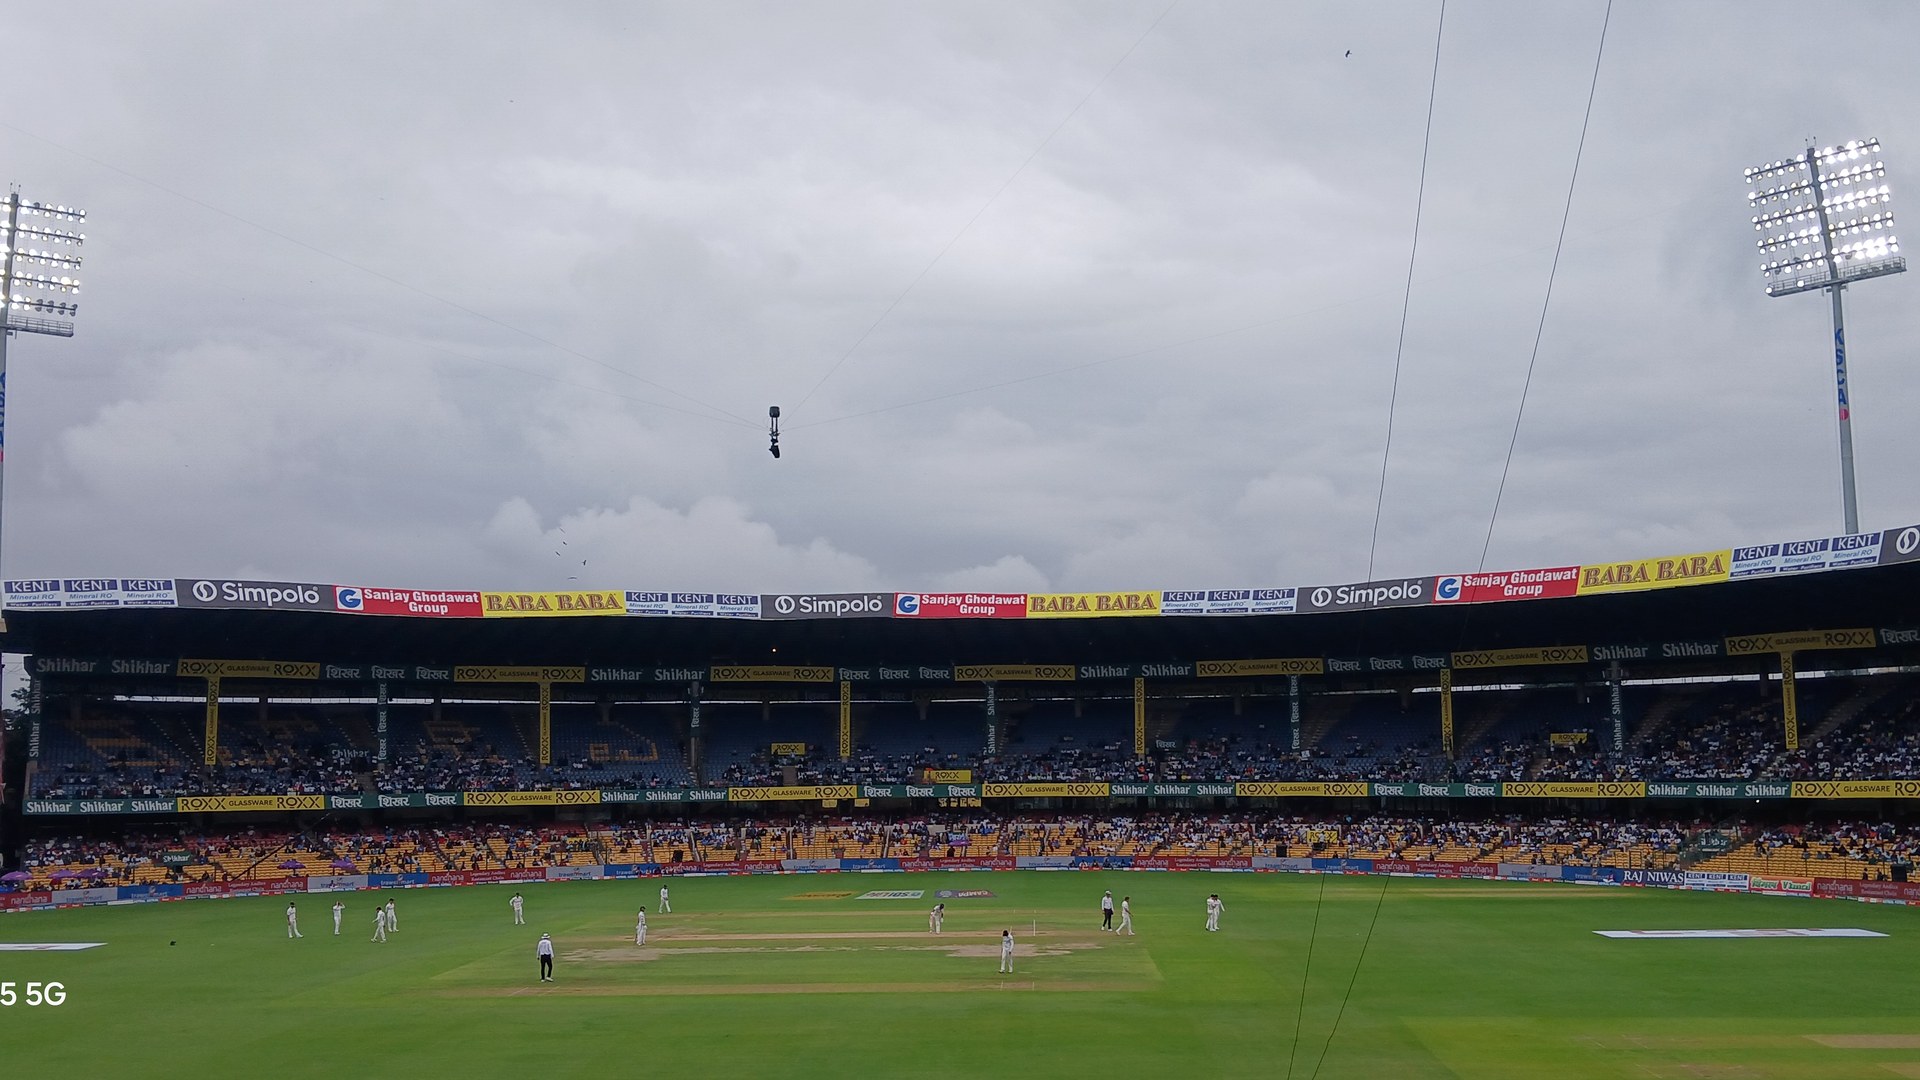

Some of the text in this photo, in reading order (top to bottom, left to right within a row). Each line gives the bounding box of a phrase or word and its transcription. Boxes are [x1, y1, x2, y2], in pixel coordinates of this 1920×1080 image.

[1788, 541, 1823, 555] KENT
[1838, 535, 1873, 549] KENT
[1738, 546, 1773, 560] KENT
[1833, 550, 1859, 559] Mineral
[1734, 561, 1760, 570] Mineral
[1784, 556, 1809, 564] Mineral
[1463, 568, 1577, 587] Sanjay Ghodawat
[1582, 555, 1725, 588] BABA BABA
[11, 581, 52, 592] KENT
[71, 580, 110, 591] KENT
[128, 580, 166, 591] KENT
[1504, 584, 1543, 597] Group
[221, 582, 320, 607] Simpolo
[364, 589, 479, 604] Sanjay Ghodawat
[631, 592, 662, 602] KENT
[675, 593, 708, 603] KENT
[720, 594, 752, 605] KENT
[921, 594, 1025, 606] Sanjay Ghodawat
[1168, 592, 1199, 601] KENT
[1213, 591, 1244, 600] KENT
[1257, 589, 1289, 600] KENT
[1335, 583, 1422, 606] Simpolo
[408, 602, 449, 615] Group
[485, 593, 623, 612] BABA BABA
[799, 595, 883, 615] Simpolo
[1030, 594, 1158, 612] BABA BABA
[960, 604, 996, 616] Group
[1728, 631, 1872, 651] ROXX ROXX
[1454, 648, 1584, 667] ROXX ROXX
[1593, 642, 1719, 660] Shikhar Shikhar
[36, 658, 170, 674] Shikhar Shikhar
[180, 662, 317, 677] ROXX ROXX
[957, 667, 993, 678] ROXX
[1035, 667, 1072, 678] ROXX
[1080, 664, 1190, 678] Shikhar Shikhar
[1200, 661, 1320, 674] ROXX ROXX
[457, 668, 498, 680] ROXX
[542, 669, 581, 680] ROXX
[591, 668, 704, 681] Shikhar Shikhar
[713, 668, 751, 679] ROXX
[793, 668, 831, 680] ROXX
[732, 788, 771, 799] ROXX
[815, 787, 854, 798] ROXX
[863, 784, 977, 797] शिखर शिखर शिखर
[985, 784, 1023, 796] ROXX
[1067, 783, 1105, 795] ROXX
[1111, 784, 1234, 795] Shikhar Shikhar Shikhar
[1239, 783, 1278, 795] ROXX
[1324, 783, 1364, 795] ROXX
[1374, 783, 1496, 796] शिखर शिखर शिखर
[1505, 783, 1548, 796] ROXX
[1597, 783, 1641, 796] ROXX
[1648, 784, 1789, 796] Shikhar Shikhar Shikhar
[1794, 783, 1841, 796] ROXX
[1844, 785, 1891, 793] GLASSWARE
[331, 793, 457, 809] शिखर शिखर शिखर
[467, 792, 509, 804] ROXX
[556, 791, 596, 803] ROXX
[602, 790, 727, 802] Shikhar Shikhar Shikhar
[27, 800, 174, 813] Shikhar Shikhar Shikhar
[181, 798, 226, 811] ROXX
[277, 797, 321, 809] ROXX
[1624, 871, 1684, 884] RAJ NIWAS
